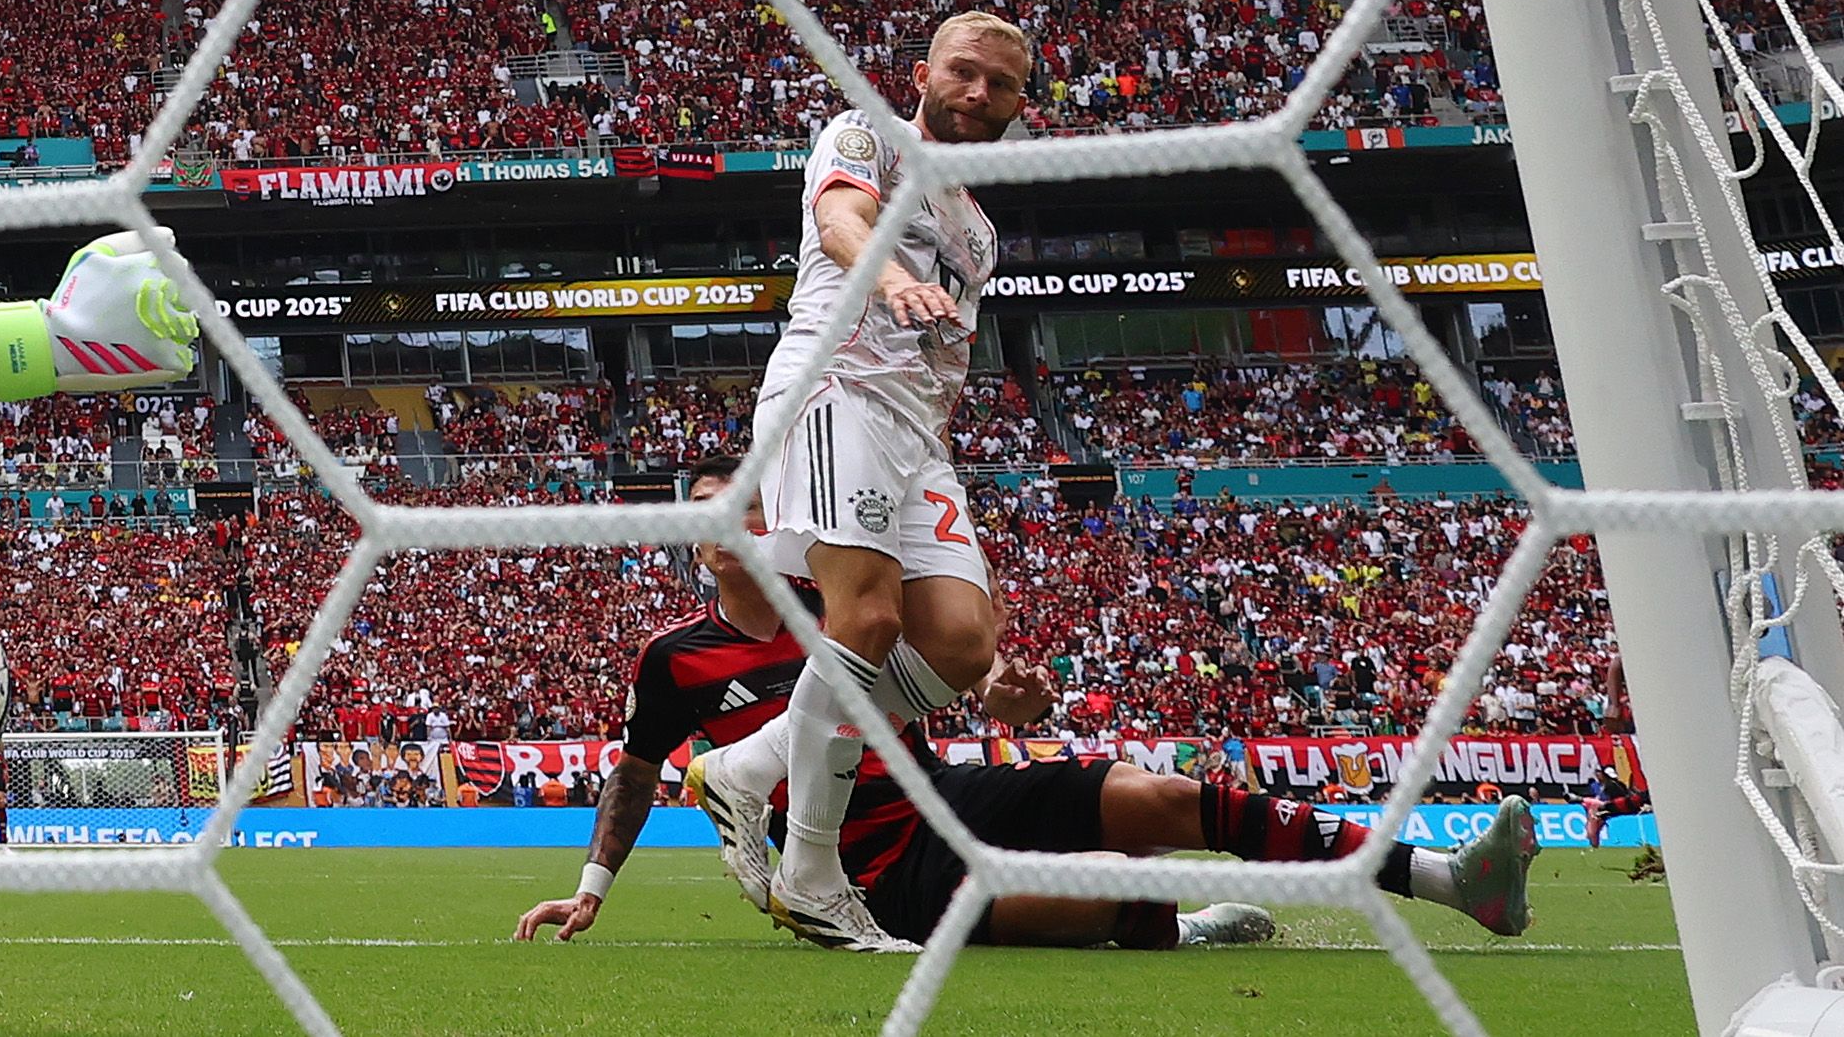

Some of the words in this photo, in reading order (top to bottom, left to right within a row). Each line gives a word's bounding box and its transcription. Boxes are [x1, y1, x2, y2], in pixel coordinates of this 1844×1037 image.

[477, 161, 571, 181] THOMAS
[578, 157, 610, 179] 54
[258, 168, 426, 201] FLAMIAMI
[1068, 273, 1118, 294] CUP
[1286, 267, 1342, 288] FIFA
[1414, 262, 1510, 284] WORLD
[234, 298, 281, 318] CUP
[435, 292, 487, 312] FIFA
[489, 290, 550, 312] CLUB
[553, 287, 639, 310] WORLD
[643, 286, 691, 306] CUP
[88, 749, 109, 759] CUP
[1257, 742, 1332, 787] FLA
